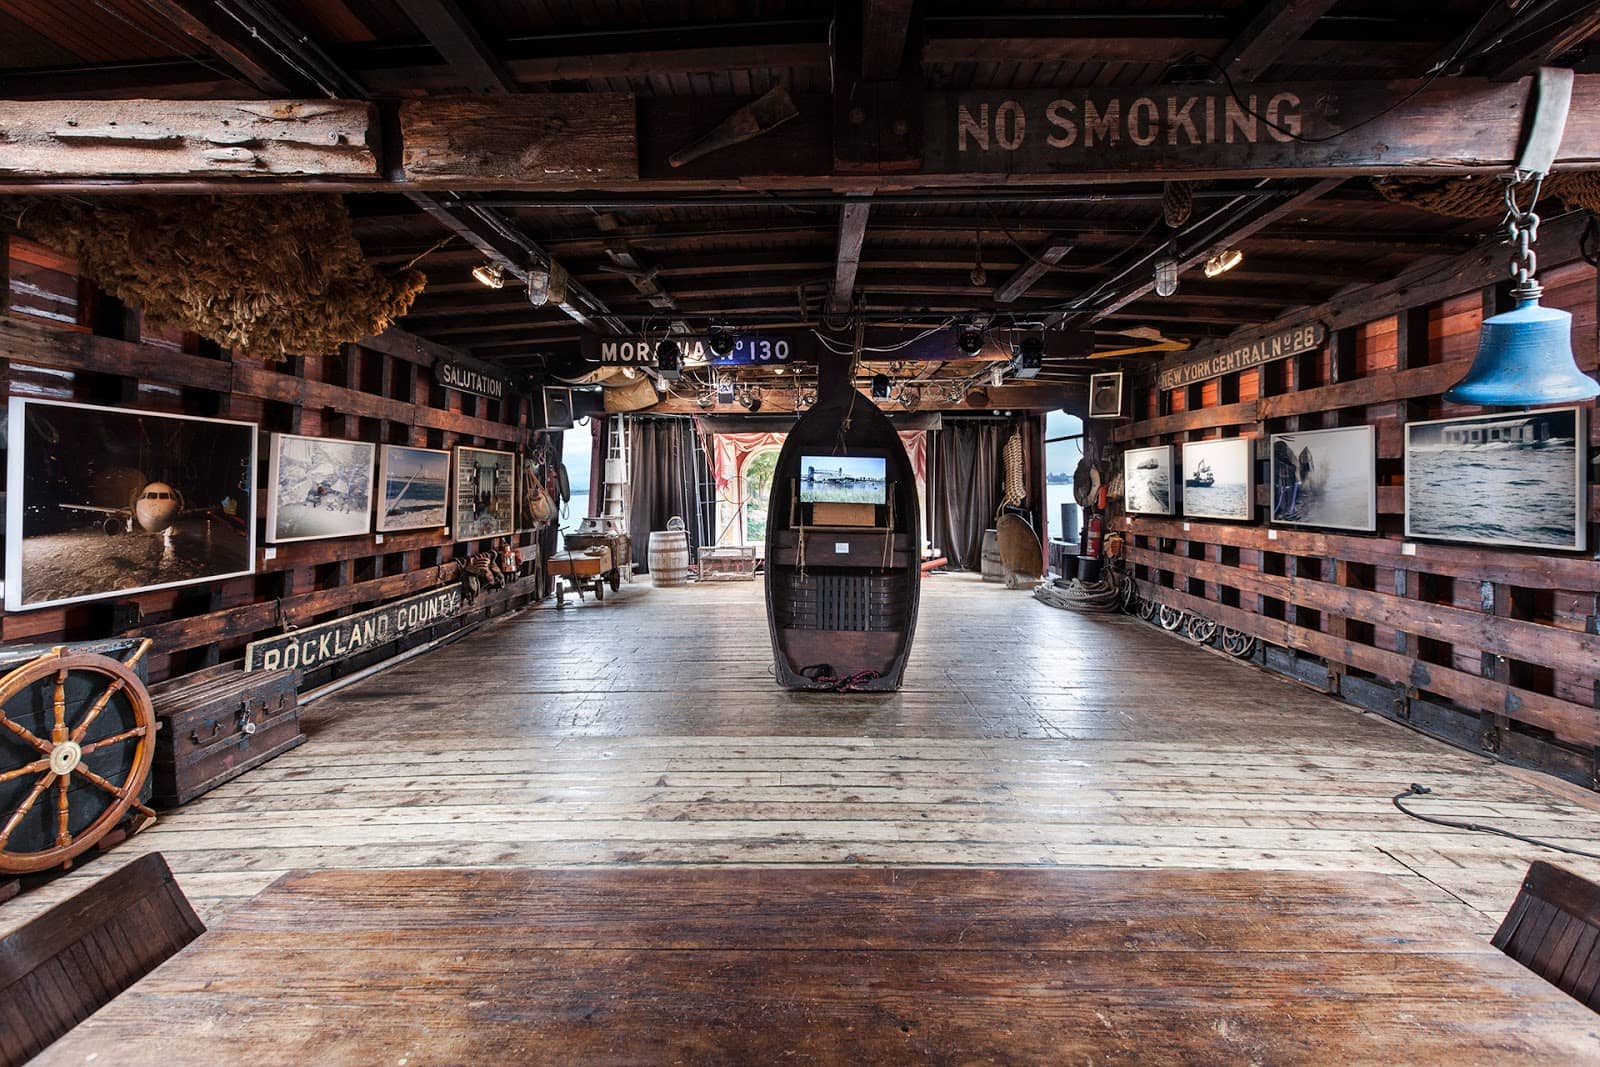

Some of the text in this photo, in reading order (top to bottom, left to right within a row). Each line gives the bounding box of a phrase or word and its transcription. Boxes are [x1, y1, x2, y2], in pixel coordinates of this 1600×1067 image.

[957, 91, 1303, 151] NO SMOKING
[443, 364, 502, 397] SALUTATION
[750, 340, 790, 361] 130
[1160, 369, 1183, 388] NEW
[1184, 360, 1212, 382] YORK
[1212, 341, 1270, 374] CENTRAL
[1293, 326, 1315, 351] 26
[263, 590, 458, 671] ROCKLAND COUNTY
